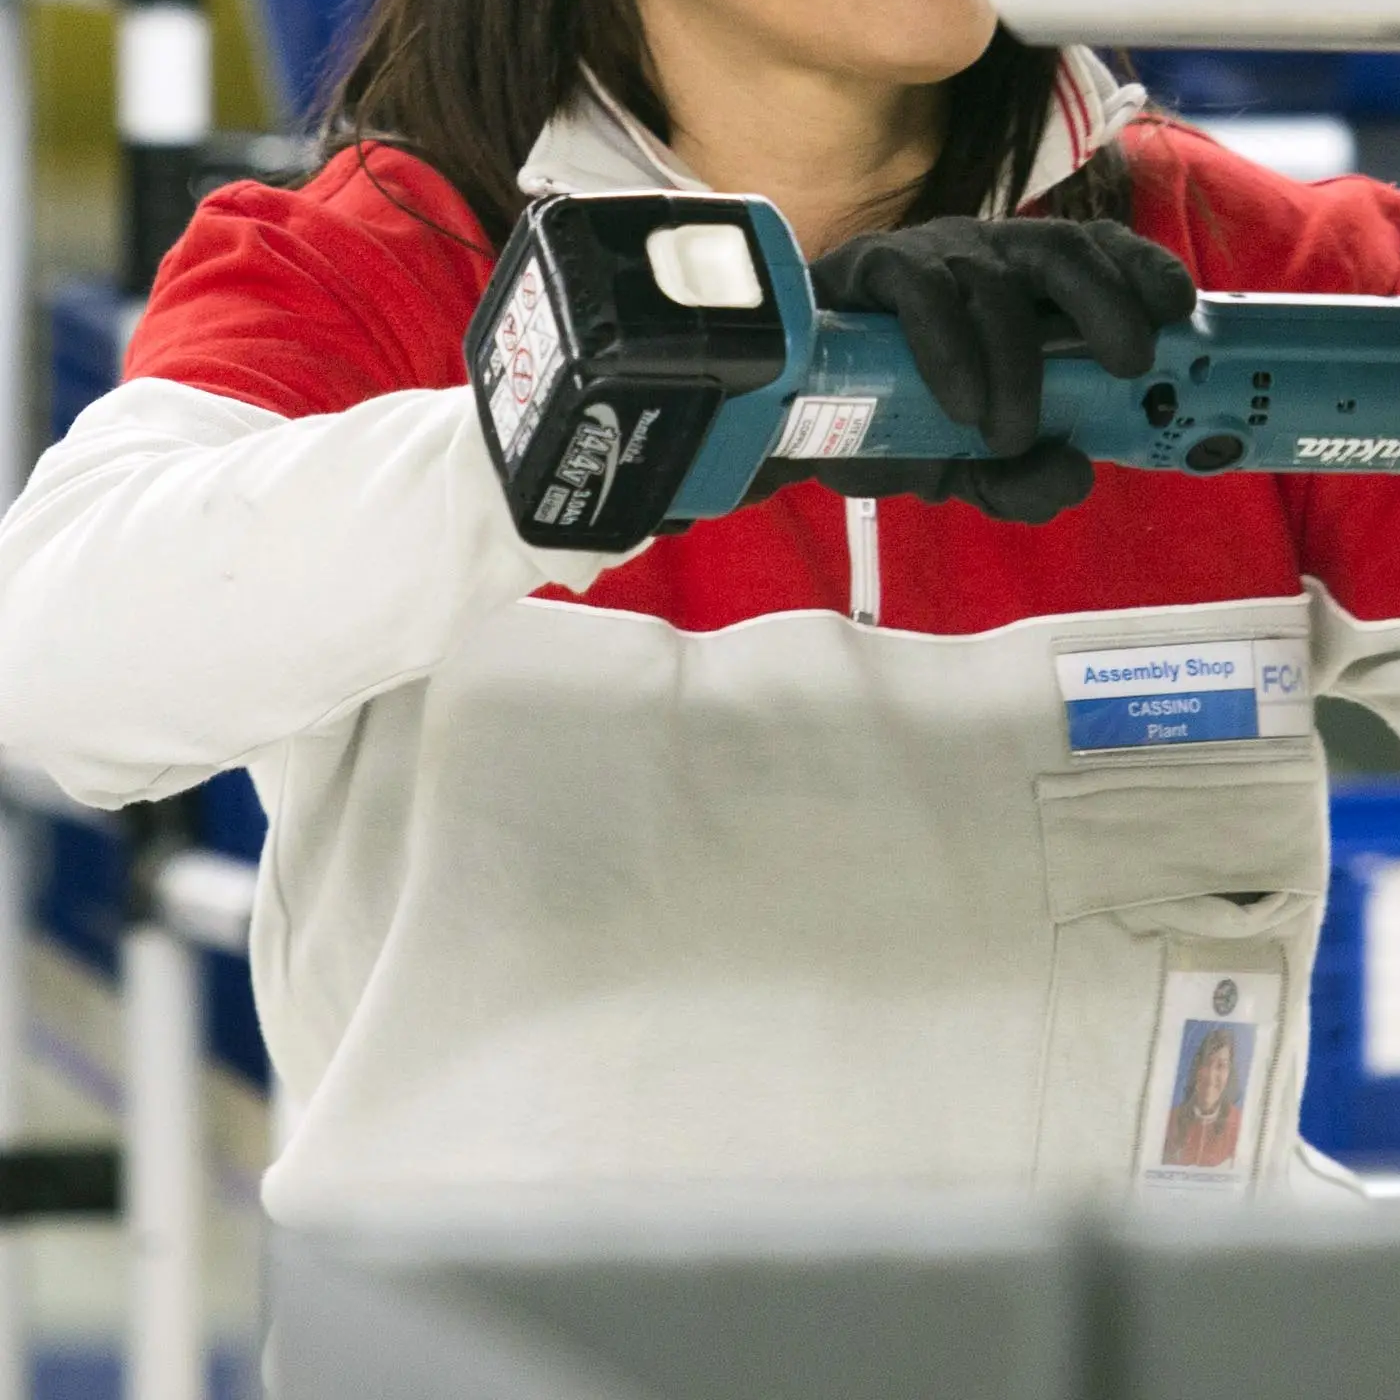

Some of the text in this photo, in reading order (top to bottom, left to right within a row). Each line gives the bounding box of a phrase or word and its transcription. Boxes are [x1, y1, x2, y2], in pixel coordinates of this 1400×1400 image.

[1083, 658, 1235, 685] Assembly Shop
[1128, 697, 1201, 718] CASSINO
[1147, 723, 1189, 739] Plant
